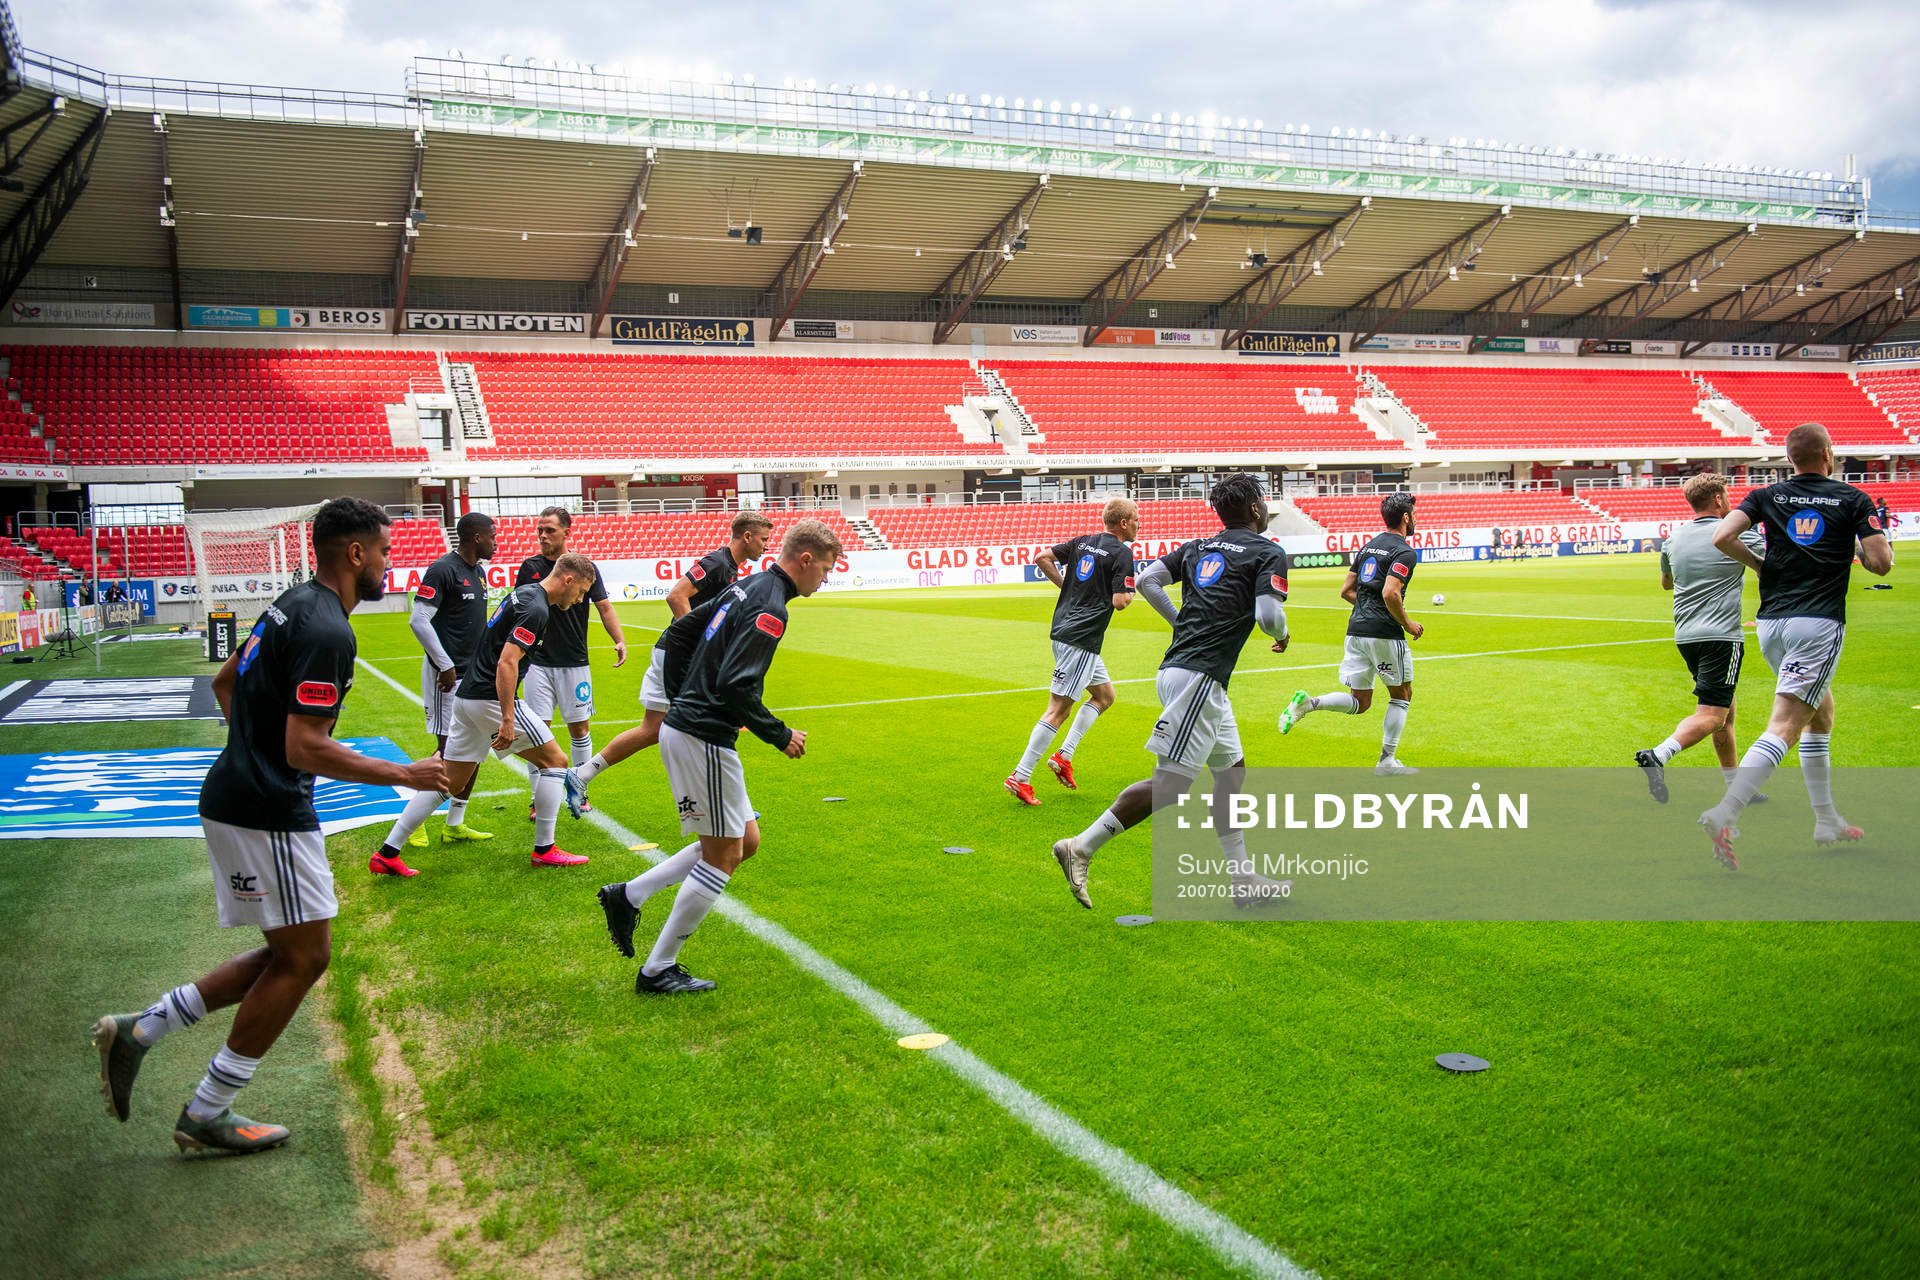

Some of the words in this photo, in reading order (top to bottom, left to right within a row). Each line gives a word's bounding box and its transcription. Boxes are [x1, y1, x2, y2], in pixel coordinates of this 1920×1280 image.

[440, 102, 480, 117] ABRO
[556, 112, 594, 126] ABRO
[665, 121, 700, 134] ABRO
[106, 308, 151, 321] Solutions
[319, 310, 381, 324] BEROS
[615, 320, 735, 345] GuldFågeln
[1160, 331, 1191, 342] AddVoice
[1241, 335, 1326, 356] GuldFågeln
[304, 468, 318, 476] joli
[1790, 496, 1841, 507] POLARIS
[1550, 526, 1562, 542] &
[1567, 524, 1622, 542] GRATIS
[1794, 518, 1819, 535] W
[907, 549, 967, 570] GLAD
[976, 547, 993, 567] &
[1080, 560, 1093, 574] W
[1200, 560, 1222, 578] W
[1364, 564, 1376, 576] W
[216, 622, 228, 659] SELECT
[1782, 661, 1808, 676] stc
[580, 685, 589, 698] N
[230, 872, 257, 892] stc
